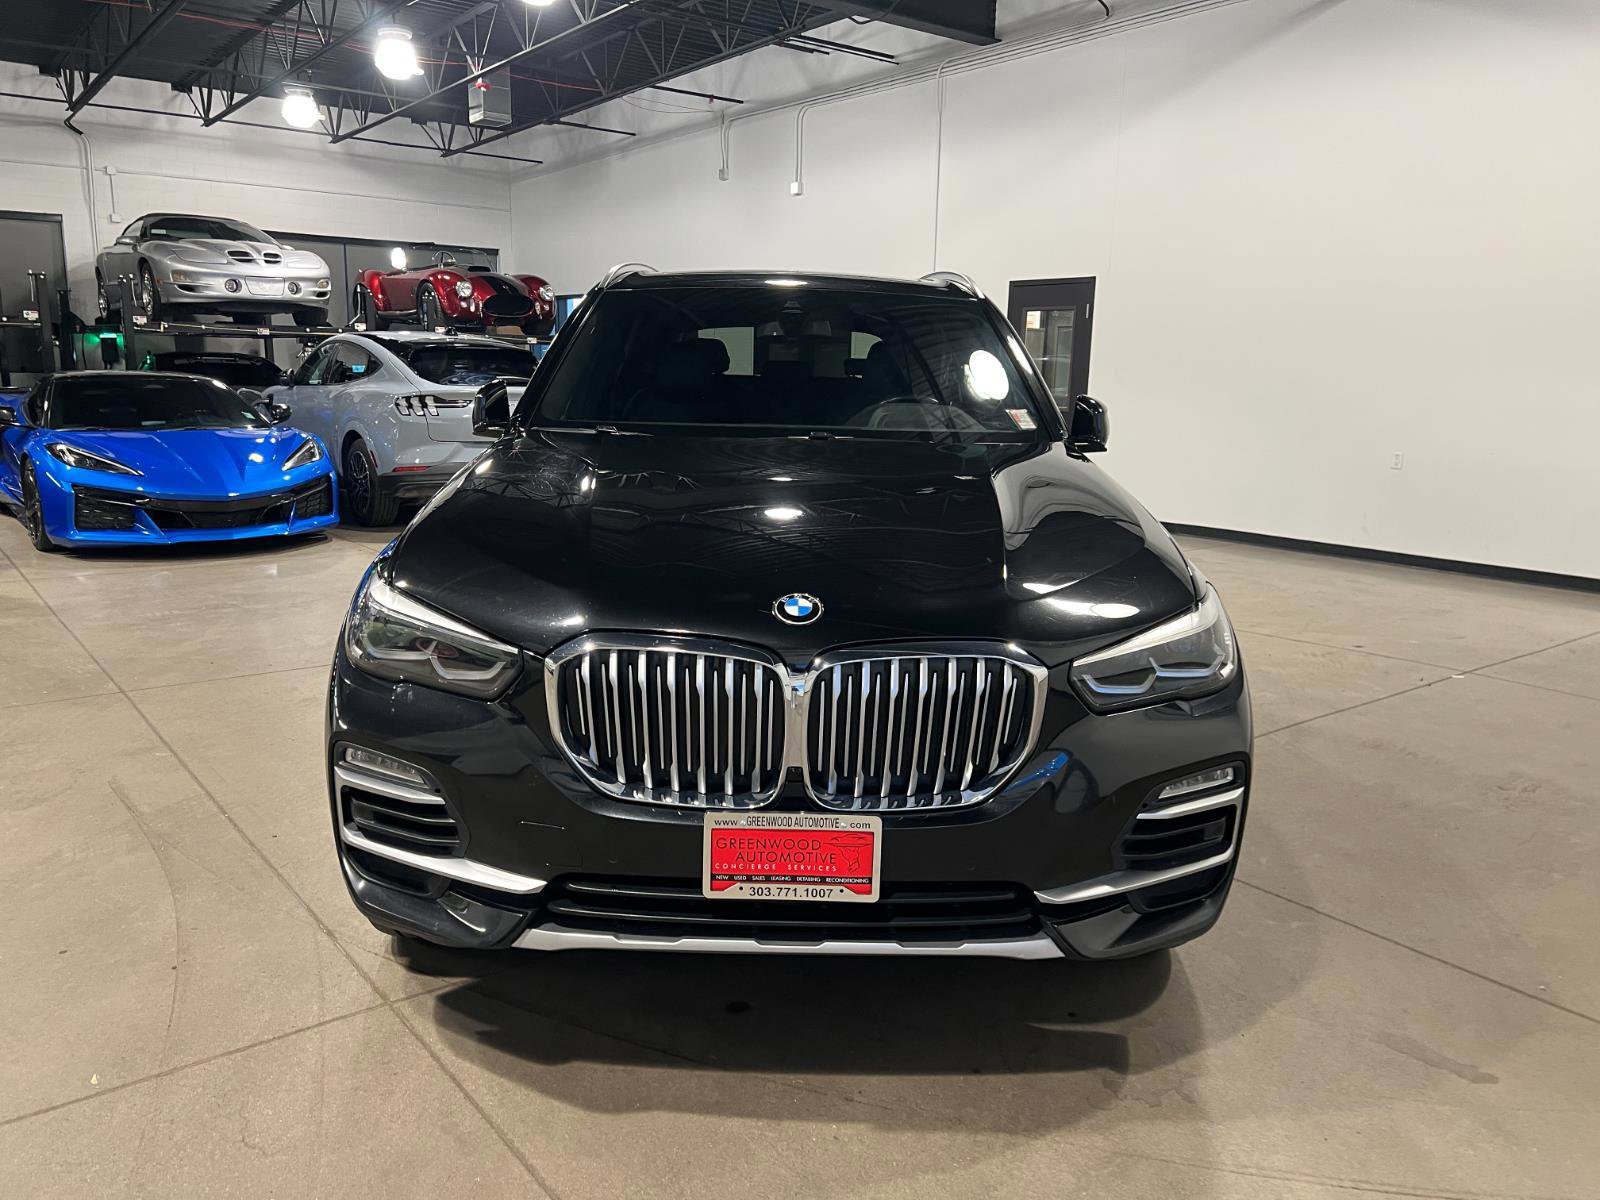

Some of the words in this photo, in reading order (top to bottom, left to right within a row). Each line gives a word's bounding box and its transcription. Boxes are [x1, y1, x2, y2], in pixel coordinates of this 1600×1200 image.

[746, 815, 792, 827] GREENWOOD
[794, 816, 840, 829] AUTOMOTIVE
[716, 837, 821, 851] GREENWOOD
[736, 850, 837, 865] AUTOMOTIVE
[715, 863, 777, 871] CONCIERGE
[787, 864, 837, 872] SERVICES
[749, 886, 834, 898] 303.771.1007
